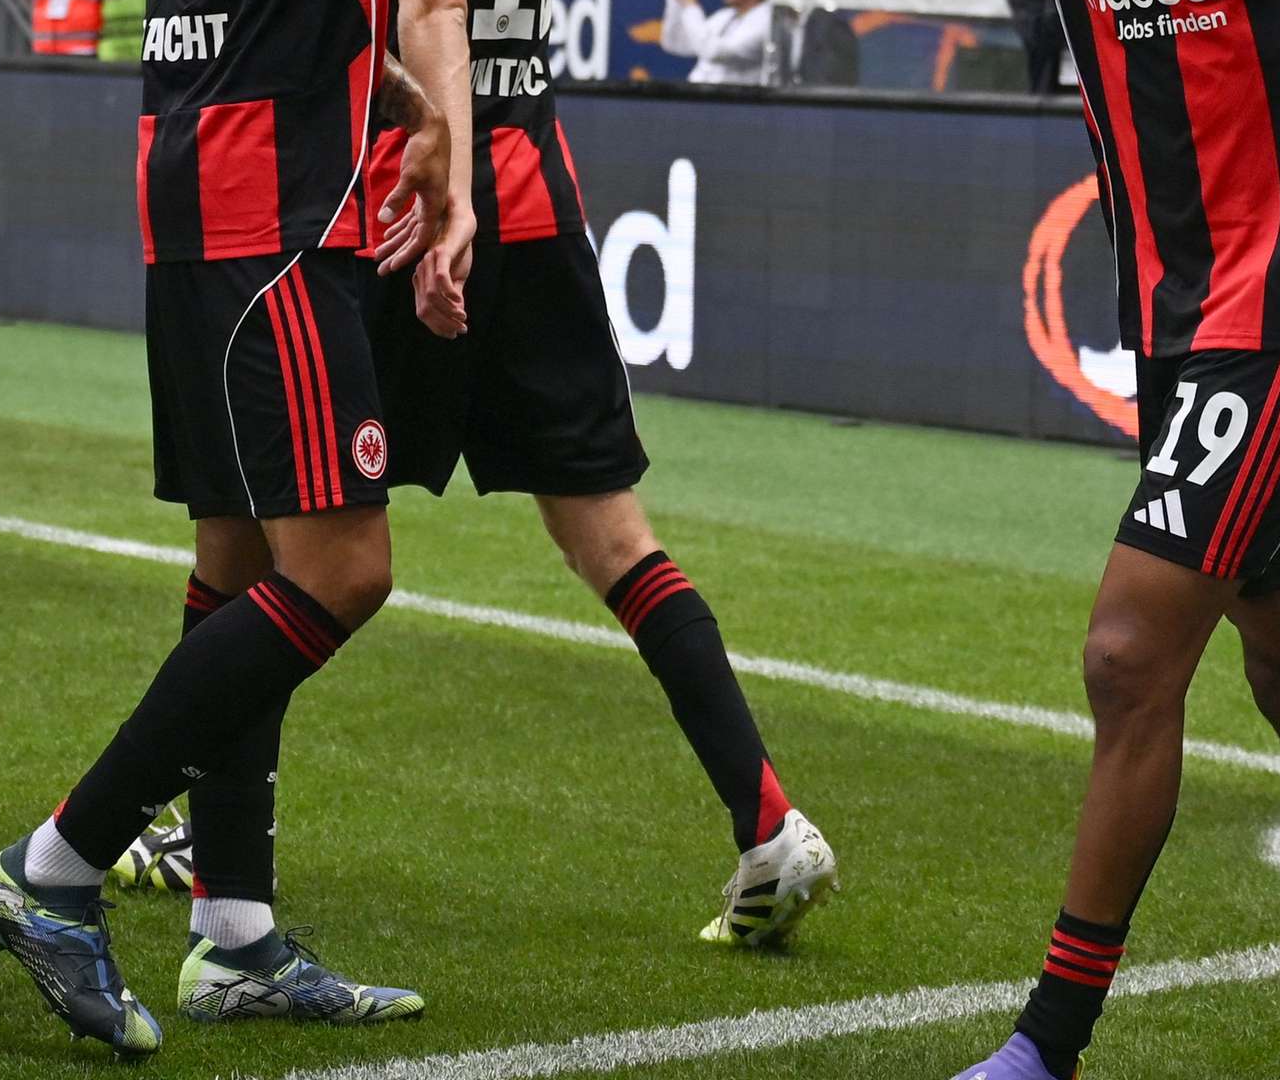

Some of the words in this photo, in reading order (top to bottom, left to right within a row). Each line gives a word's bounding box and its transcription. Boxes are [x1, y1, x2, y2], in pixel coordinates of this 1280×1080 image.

[143, 13, 228, 62] ACHT
[1118, 18, 1154, 40] Jobs
[1157, 11, 1227, 36] finden
[1146, 382, 1248, 486] 19
